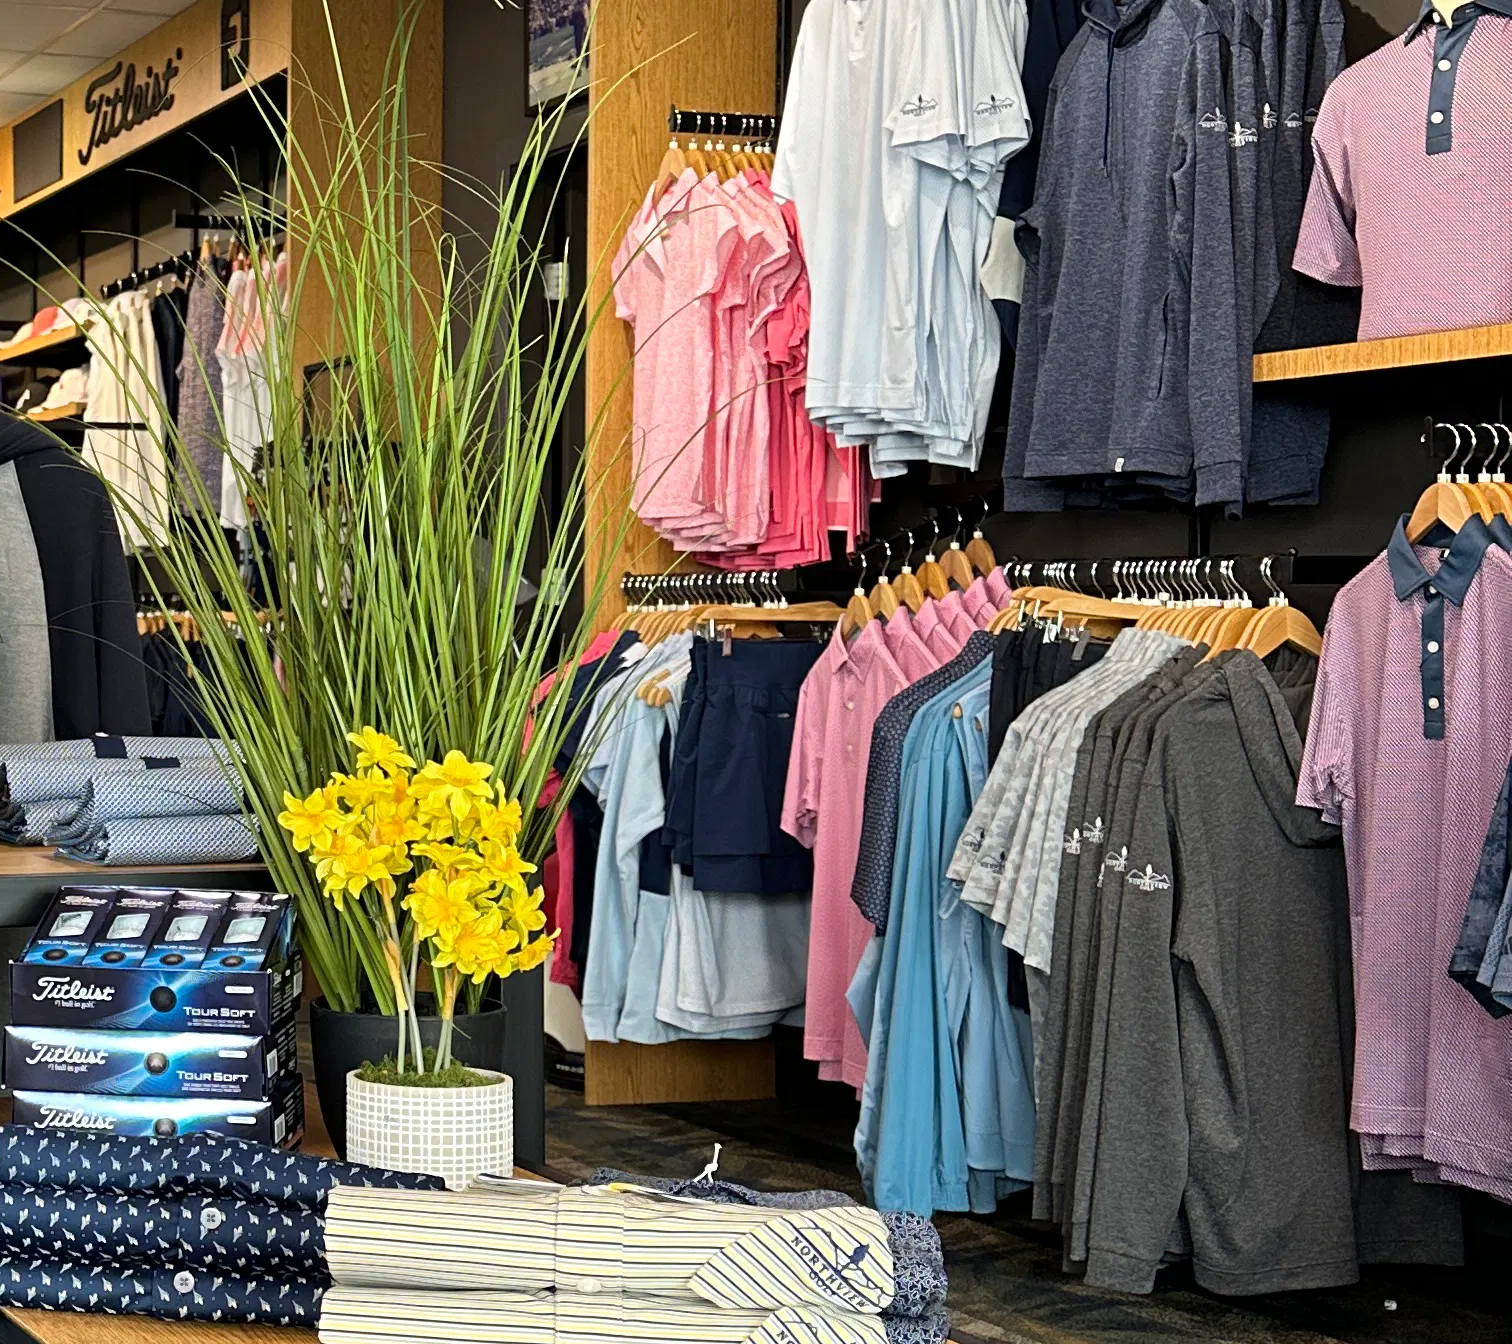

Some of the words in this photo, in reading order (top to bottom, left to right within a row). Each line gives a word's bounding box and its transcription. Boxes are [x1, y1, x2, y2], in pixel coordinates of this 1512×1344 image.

[78, 54, 179, 165] Titleist
[32, 976, 115, 1001] Titleist
[182, 1006, 219, 1017] TOUR
[220, 1007, 256, 1018] SOFT
[25, 1040, 109, 1065] Titleist
[175, 1070, 212, 1081] TOUR
[213, 1071, 249, 1083] SOFT
[33, 1105, 117, 1130] Titleist
[790, 1235, 870, 1308] NORTHVIEW
